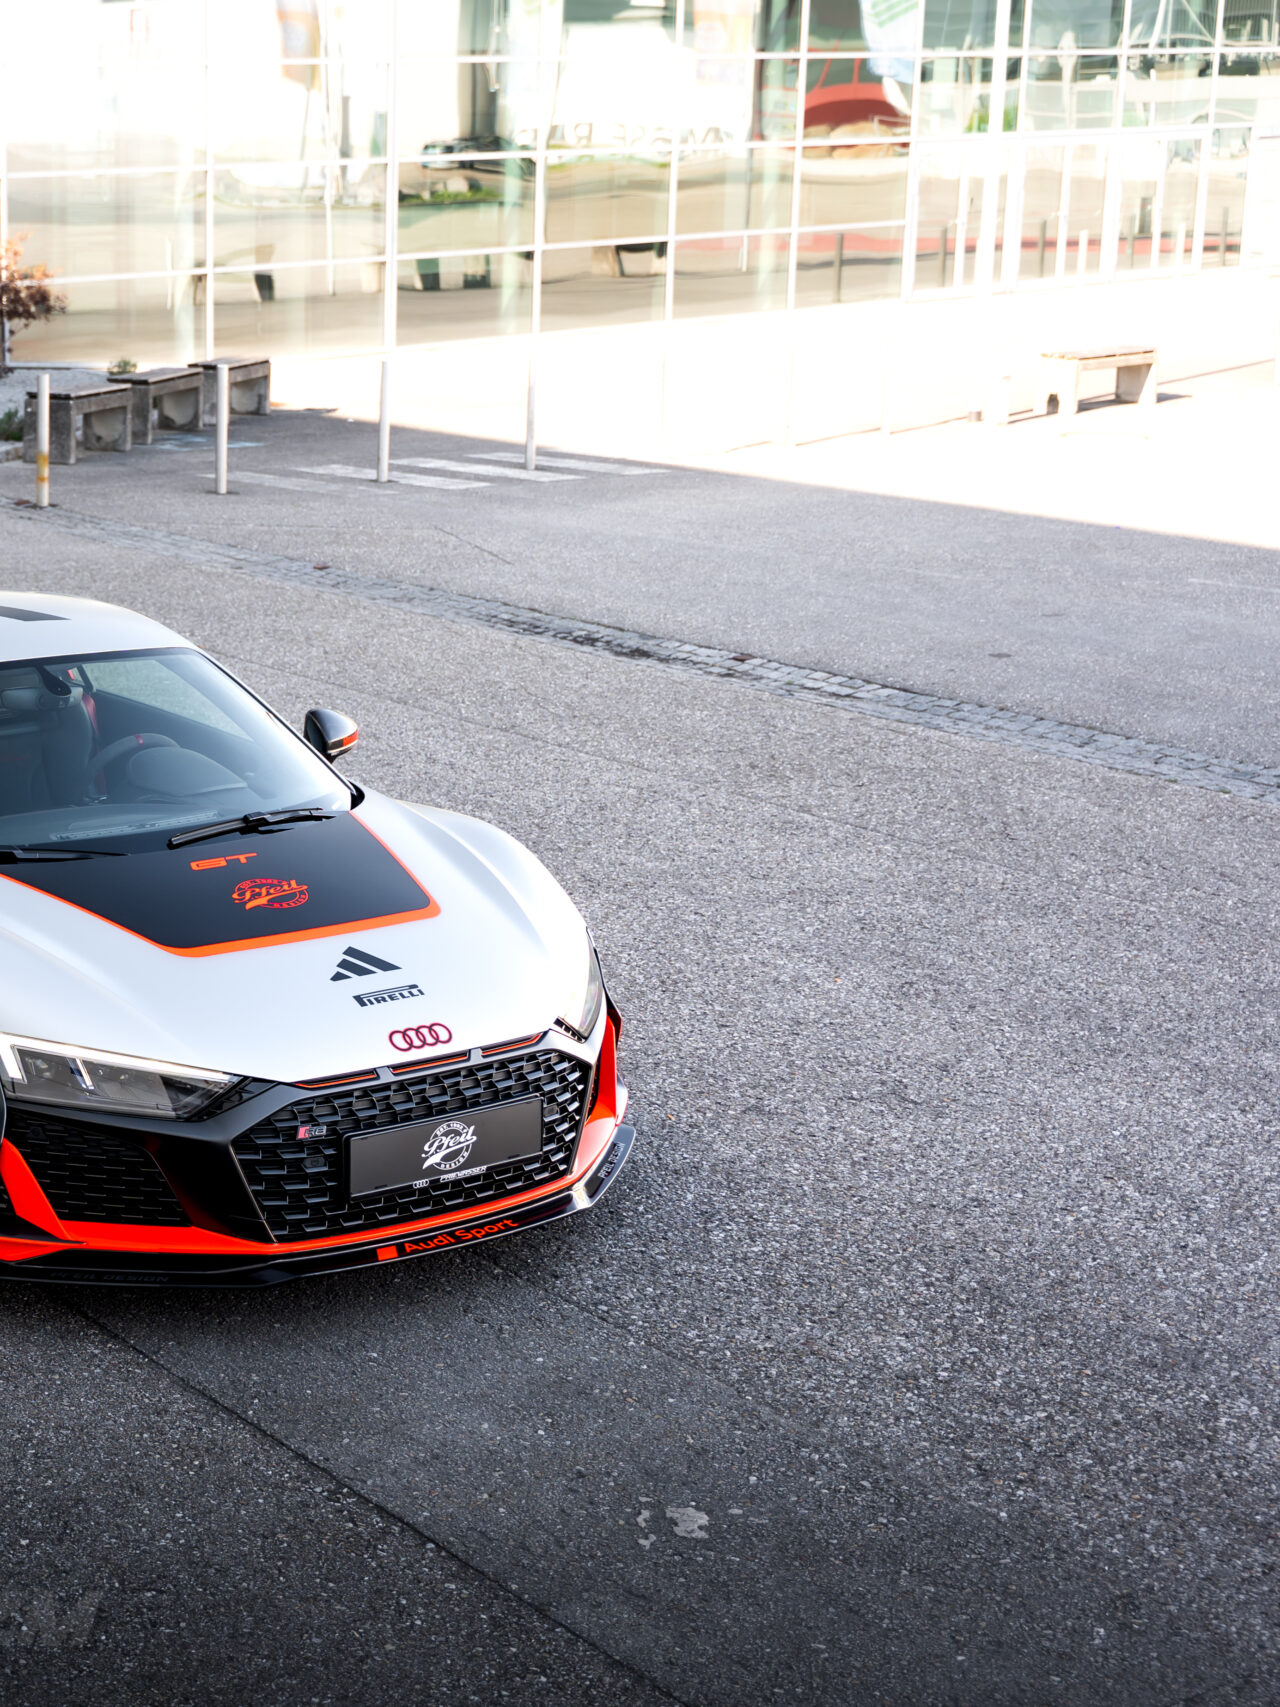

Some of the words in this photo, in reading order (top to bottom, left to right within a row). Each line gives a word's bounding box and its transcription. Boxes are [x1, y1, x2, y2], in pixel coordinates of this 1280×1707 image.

[189, 852, 258, 872] GT
[231, 879, 309, 907] Pfeil
[352, 984, 425, 1007] PIRELLI
[421, 1125, 478, 1160] Pfeil
[598, 1162, 615, 1179] PFEIL
[404, 1234, 456, 1253] Audi
[455, 1218, 519, 1239] Sport
